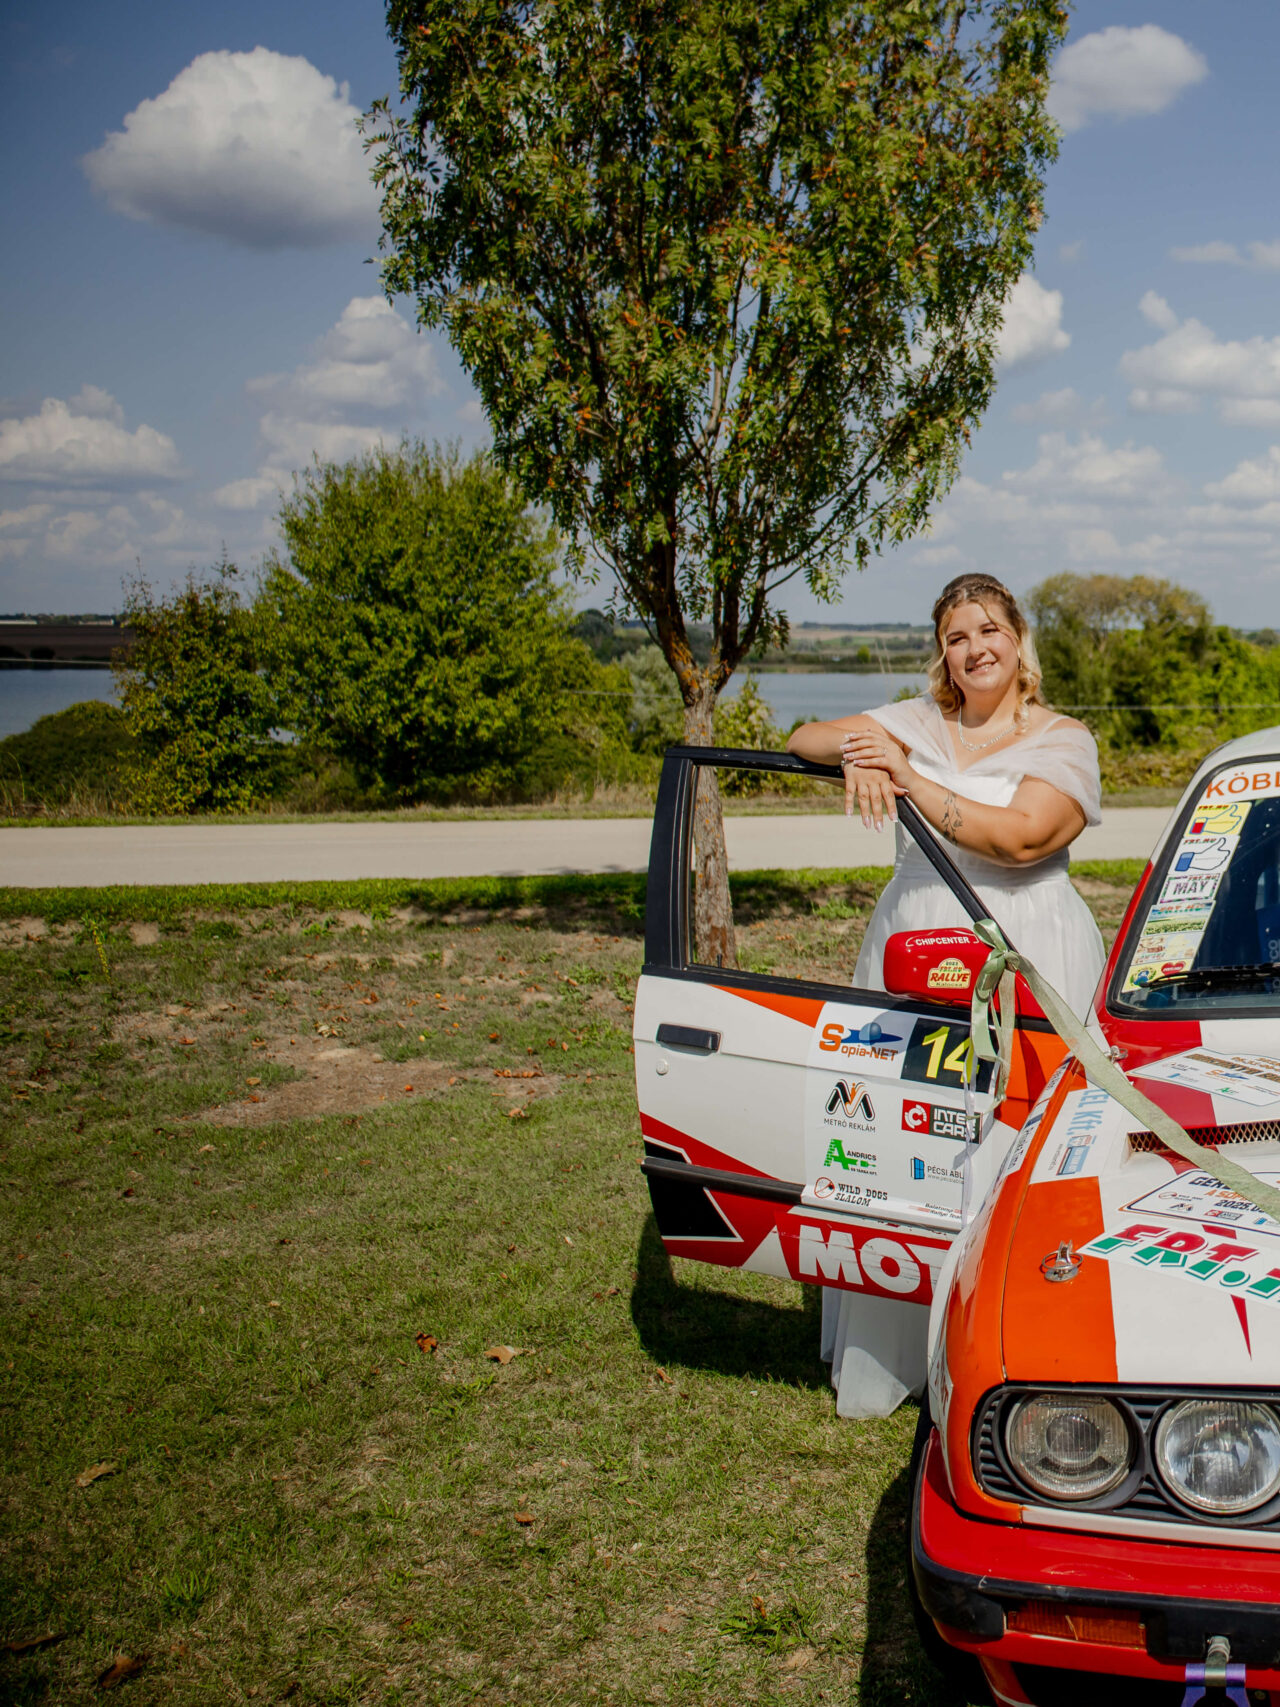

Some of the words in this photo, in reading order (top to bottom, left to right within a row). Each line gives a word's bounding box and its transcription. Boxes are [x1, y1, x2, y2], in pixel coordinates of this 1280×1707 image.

[915, 936, 971, 946] CHIPCENTER
[930, 972, 971, 982] RALLYE
[921, 1026, 980, 1084] 14
[823, 1117, 847, 1128] METRÓ
[849, 1122, 876, 1133] REKLÁM
[847, 1150, 877, 1161] ANDRICS
[927, 1164, 948, 1177] PÉCSI
[838, 1183, 861, 1195] WILD
[866, 1188, 888, 1201] DOGS
[834, 1192, 872, 1207] SLALOM
